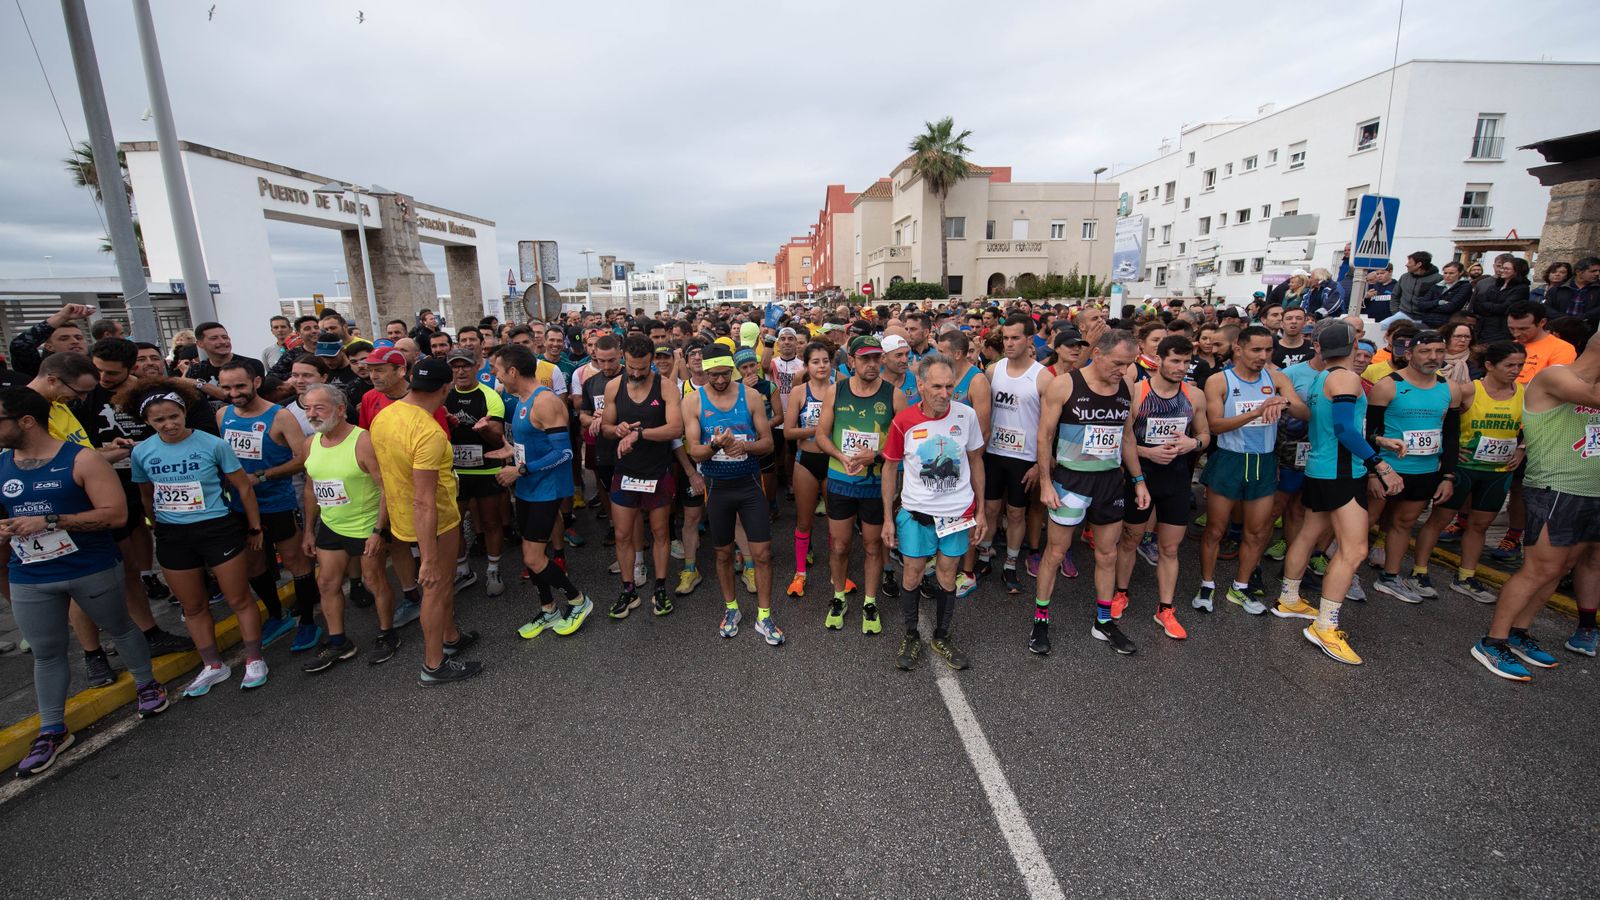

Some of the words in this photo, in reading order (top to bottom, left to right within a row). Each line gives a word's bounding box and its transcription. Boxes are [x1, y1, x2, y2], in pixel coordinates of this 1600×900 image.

[258, 177, 309, 205] PUERTO
[315, 193, 330, 209] DE
[335, 194, 371, 217] TARFA
[233, 438, 251, 450] 149
[999, 433, 1016, 444] 450
[1095, 434, 1115, 446] 168
[1418, 436, 1432, 447] 89
[1488, 445, 1509, 454] 219
[151, 460, 200, 475] nerja
[164, 491, 189, 502] 325
[15, 505, 51, 513] MADERA
[33, 539, 44, 551] 4
